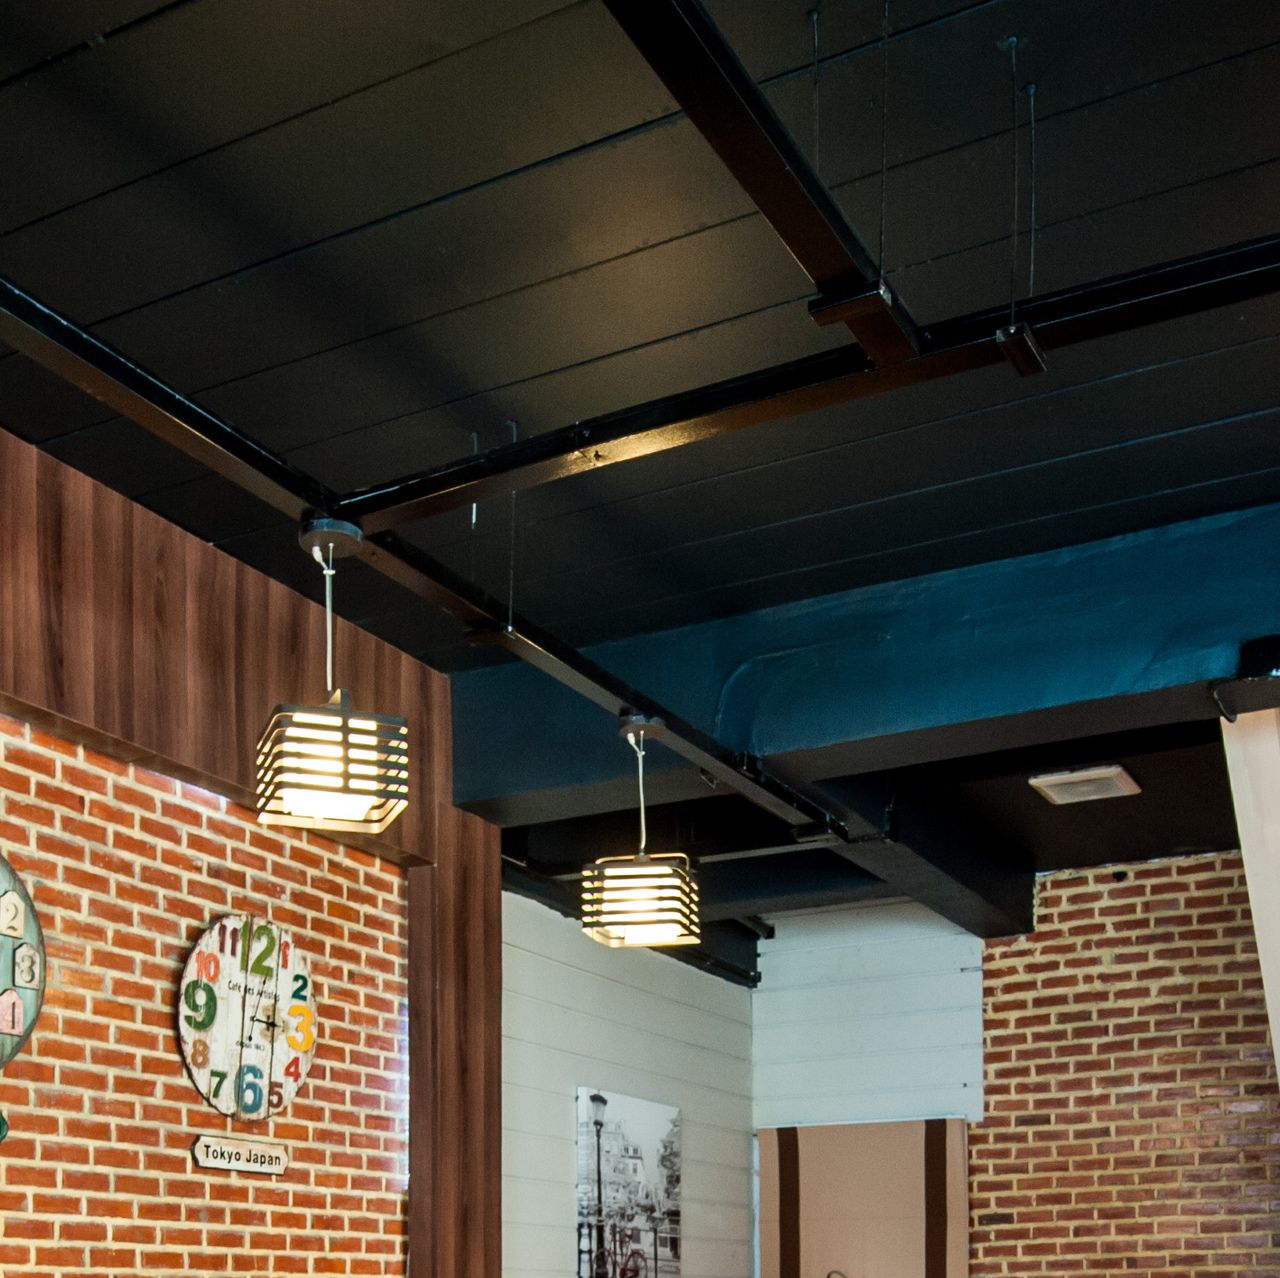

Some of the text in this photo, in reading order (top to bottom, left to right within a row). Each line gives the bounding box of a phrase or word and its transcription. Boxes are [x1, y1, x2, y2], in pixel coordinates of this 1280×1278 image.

[5, 902, 20, 933] 2
[219, 922, 239, 958] 11
[240, 915, 277, 978] 12
[280, 940, 291, 970] 1
[19, 951, 36, 984] 3
[195, 948, 220, 983] 10
[291, 973, 309, 1001] 2
[183, 979, 218, 1032] 9
[286, 1004, 315, 1053] 3
[190, 1038, 209, 1069] 8
[209, 1068, 227, 1099] 7
[284, 1056, 302, 1083] 4
[234, 1063, 264, 1115] 6
[268, 1081, 283, 1110] 5
[203, 1144, 281, 1168] Tokyo Japan
